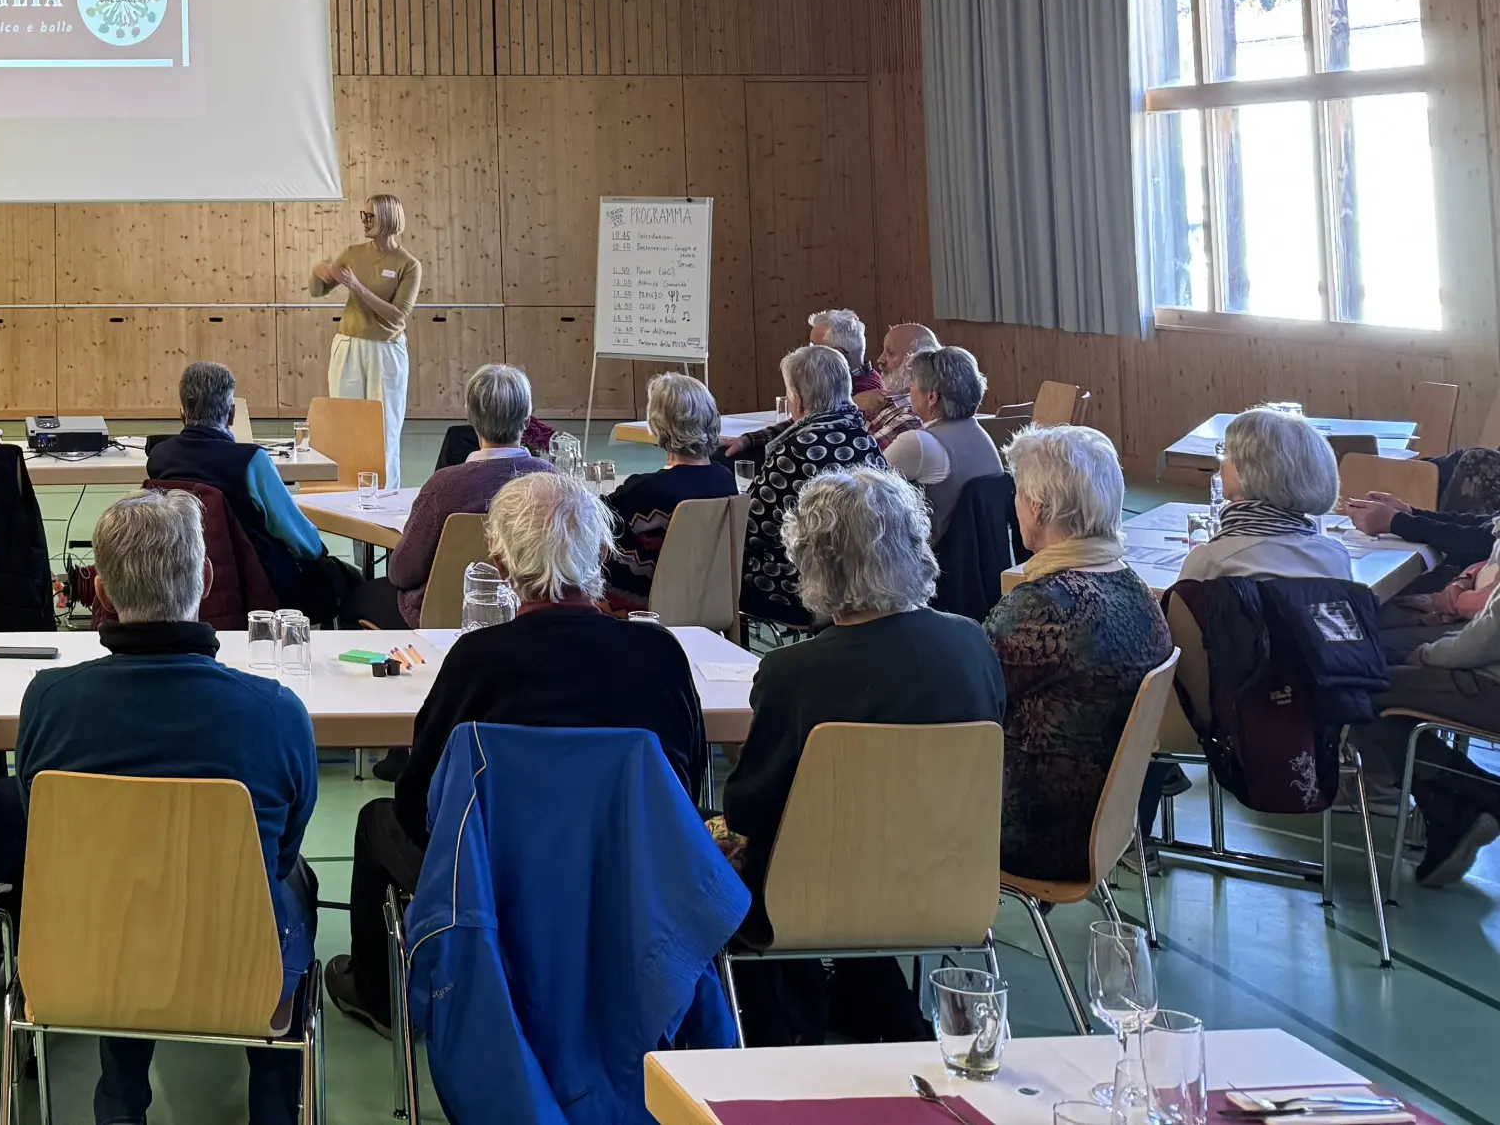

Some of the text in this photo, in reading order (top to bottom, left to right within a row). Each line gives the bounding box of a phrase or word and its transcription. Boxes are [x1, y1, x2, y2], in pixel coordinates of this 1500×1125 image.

[27, 24, 34, 33] e
[40, 21, 73, 33] ballo
[630, 207, 692, 225] PROGRAMMA
